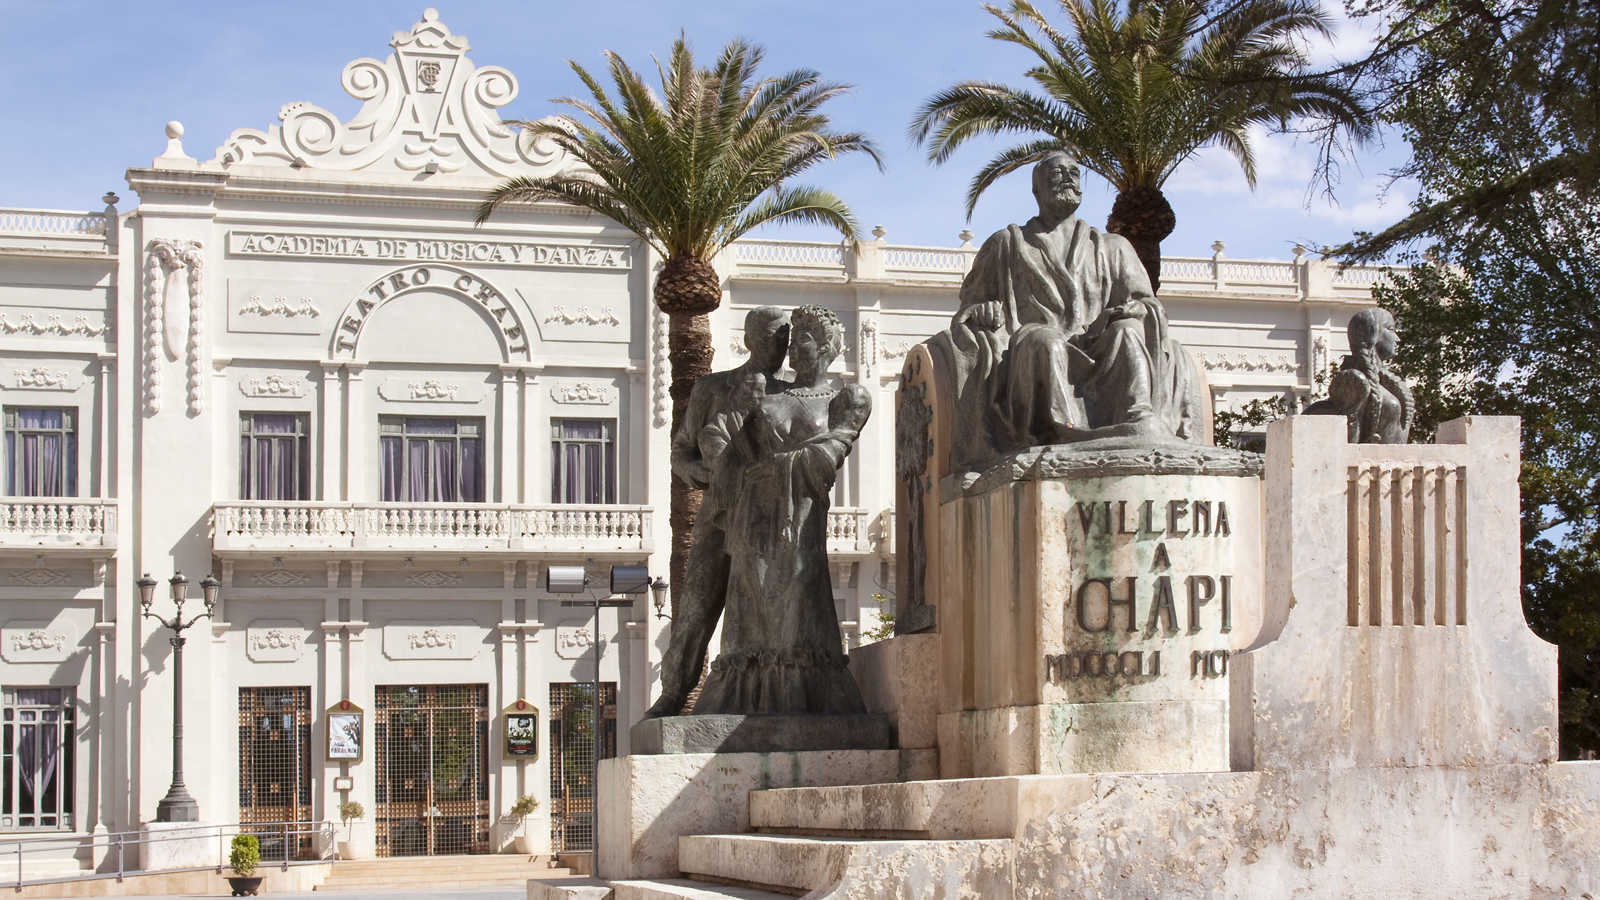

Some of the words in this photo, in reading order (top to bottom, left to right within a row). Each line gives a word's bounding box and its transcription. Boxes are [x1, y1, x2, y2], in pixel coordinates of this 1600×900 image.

[241, 234, 368, 257] ACADEMIA
[376, 239, 408, 258] DE
[416, 240, 505, 262] MUSICA
[511, 244, 528, 263] Y
[534, 245, 618, 267] DANZA
[336, 268, 430, 353] TEATRO
[454, 275, 527, 355] CHAPI
[1075, 498, 1232, 537] VILLENA
[1075, 575, 1233, 638] CHAPI
